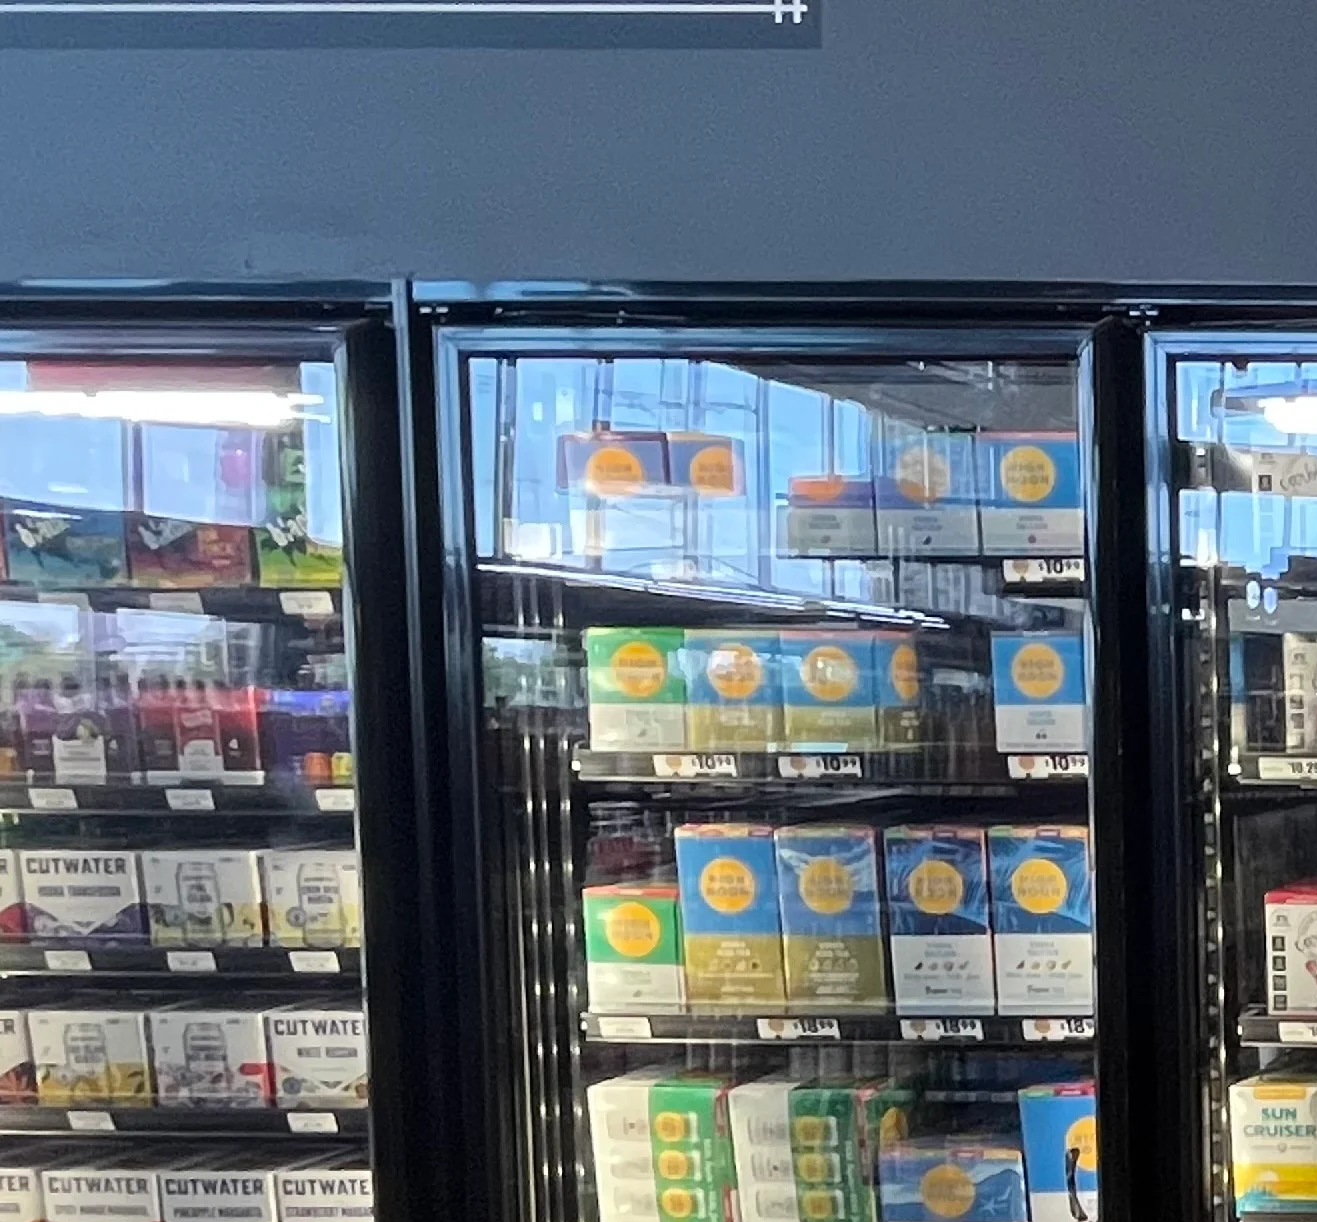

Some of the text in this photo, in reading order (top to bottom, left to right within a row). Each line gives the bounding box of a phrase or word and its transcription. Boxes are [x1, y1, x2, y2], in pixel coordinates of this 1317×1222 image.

[26, 858, 127, 874] CUTWATER
[274, 1019, 367, 1036] CUTWATE
[1261, 1108, 1297, 1122] SUN
[1243, 1124, 1317, 1139] CRUISER
[48, 1177, 148, 1194] CUTWATER
[166, 1179, 263, 1195] CUTWATER
[282, 1179, 371, 1196] CUTWATE
